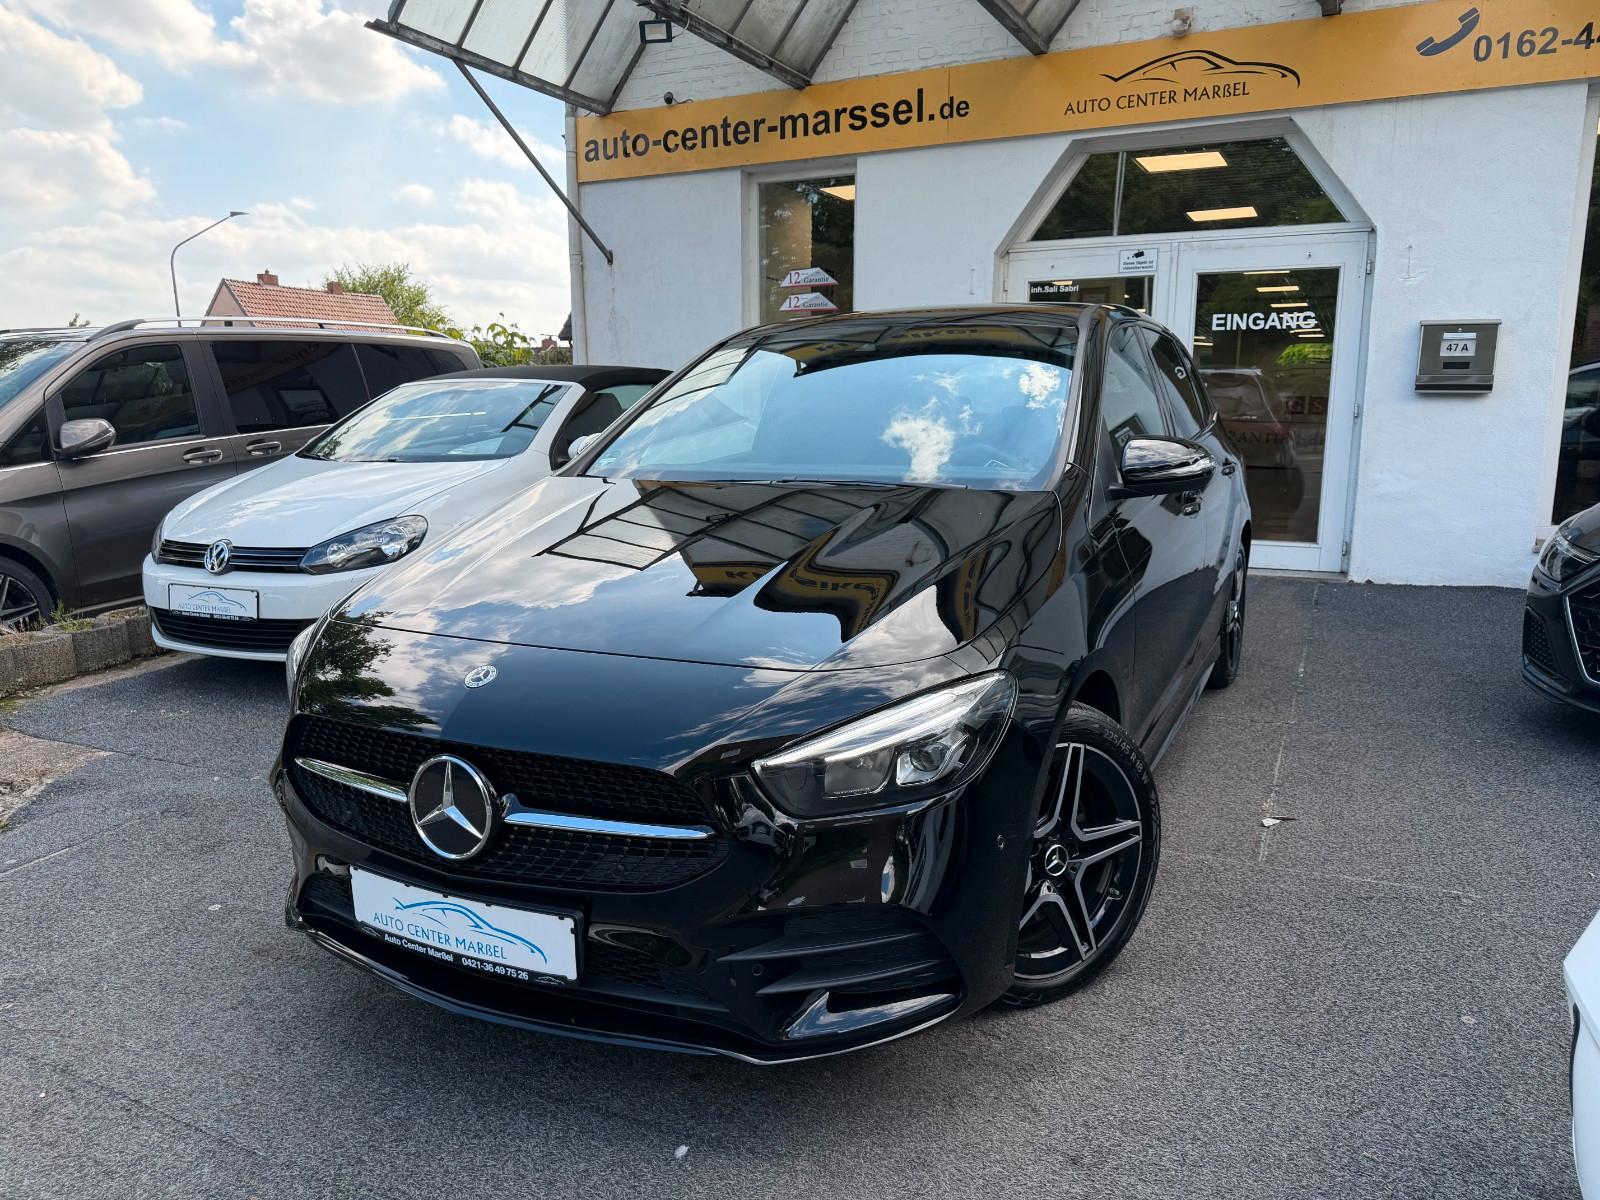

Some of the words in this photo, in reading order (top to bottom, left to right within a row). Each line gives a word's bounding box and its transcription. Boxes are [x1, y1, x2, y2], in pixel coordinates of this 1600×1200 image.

[1473, 21, 1600, 63] 0162-4
[1064, 97, 1111, 116] AUTO
[1116, 90, 1177, 110] CENTER
[584, 87, 970, 163] auto-center-marssel.de
[788, 271, 800, 284] 12
[788, 295, 800, 309] 12
[1211, 311, 1317, 331] EINGANG
[1446, 343, 1459, 352] 47
[1461, 343, 1469, 352] A
[373, 912, 404, 931] AUTO
[407, 923, 451, 946] CENTER
[384, 933, 401, 945] Auto
[402, 938, 427, 954] Center
[461, 957, 495, 973] 0421-36
[494, 966, 506, 975] 49
[505, 967, 518, 979] 75
[517, 970, 529, 981] 26
